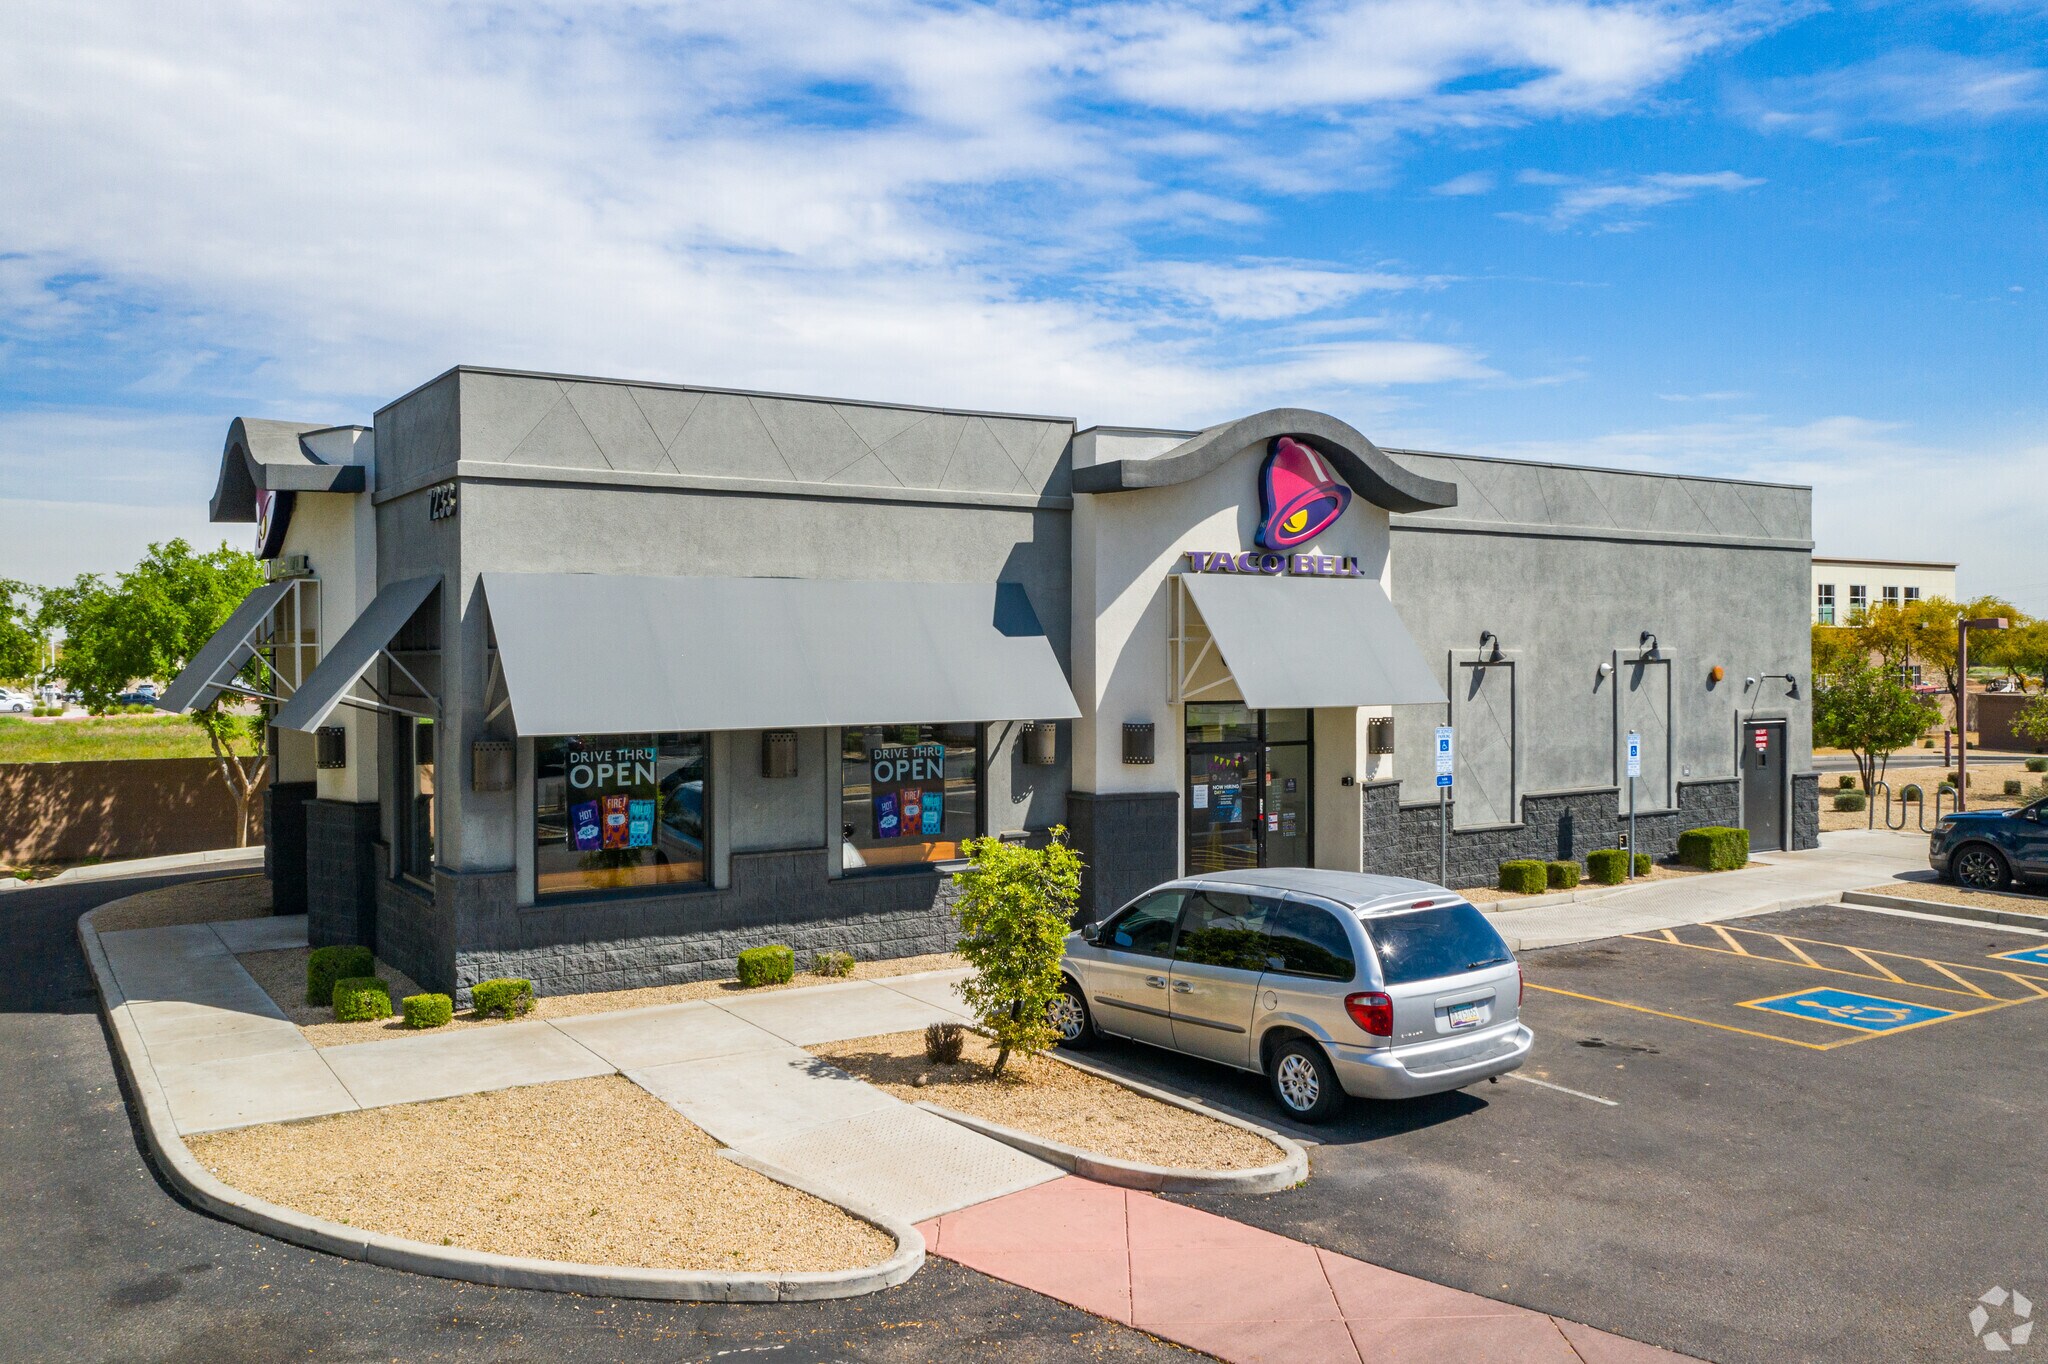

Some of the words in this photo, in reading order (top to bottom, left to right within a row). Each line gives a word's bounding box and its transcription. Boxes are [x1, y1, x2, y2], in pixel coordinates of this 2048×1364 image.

[1184, 551, 1286, 574] TACO
[1289, 553, 1365, 577] BELL
[570, 750, 612, 764] DRIVE
[616, 748, 654, 760] THRU
[874, 748, 908, 760] DRIVE
[912, 746, 943, 757] THRU
[569, 761, 655, 789] OPEN
[874, 758, 943, 782] OPEN
[607, 797, 627, 810] FIRE!
[881, 800, 893, 812] HOT
[579, 809, 592, 820] HOT
